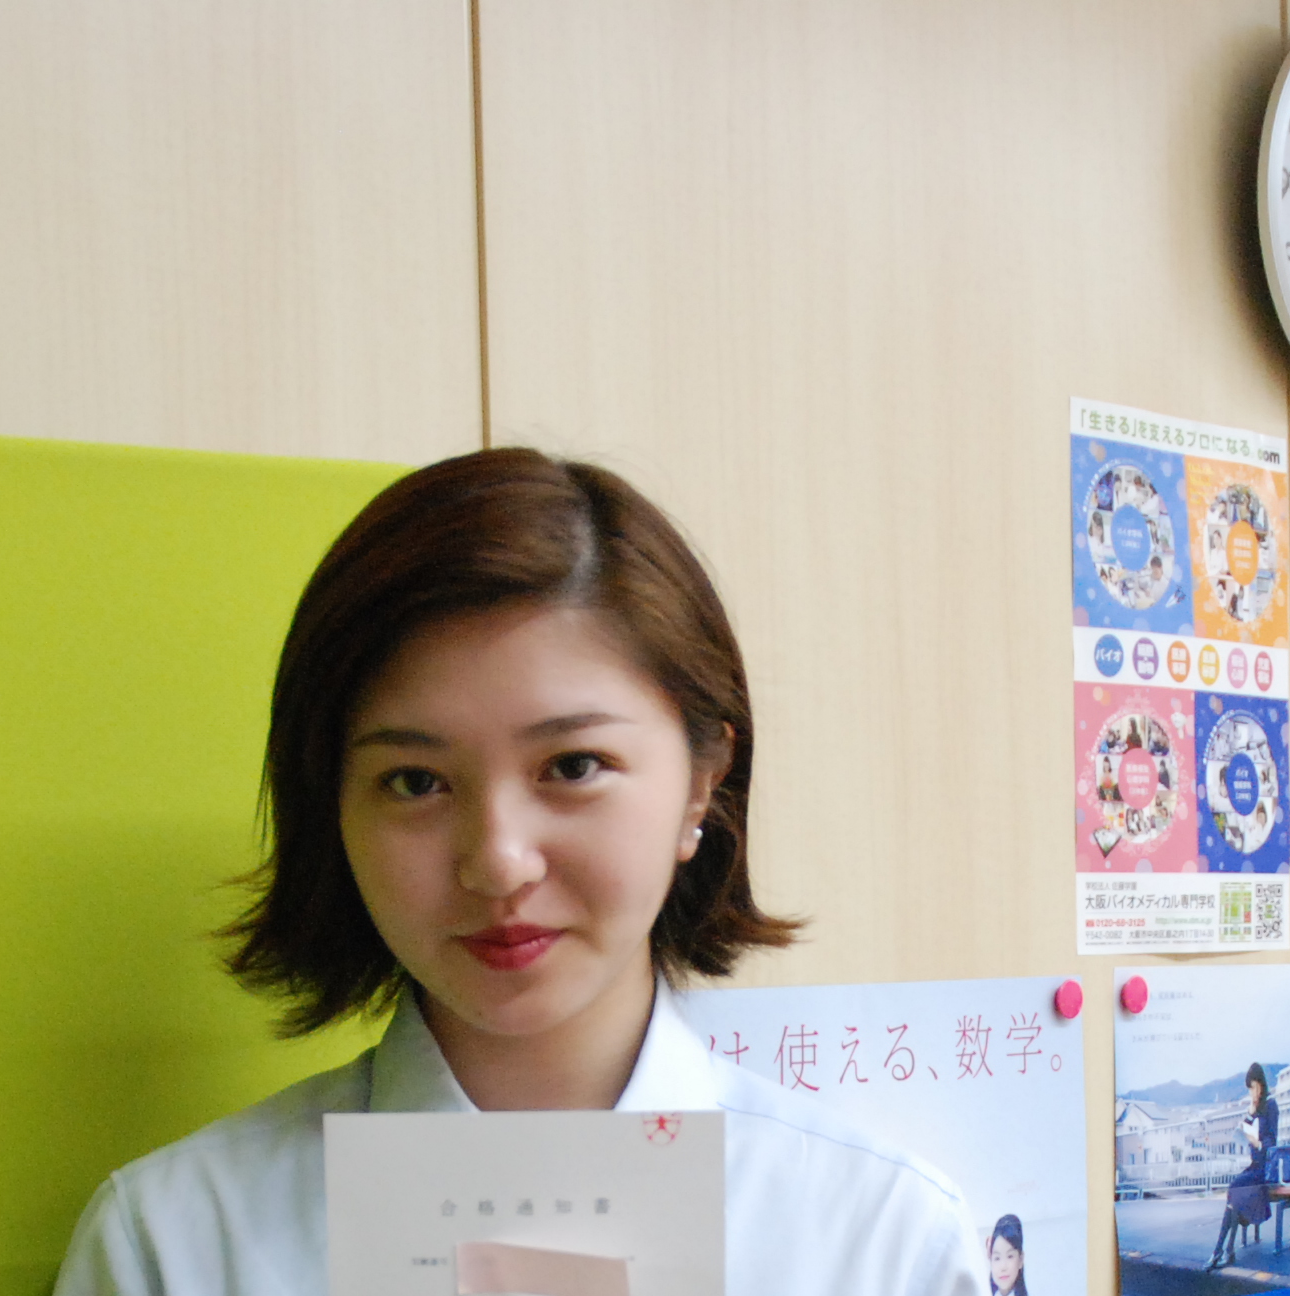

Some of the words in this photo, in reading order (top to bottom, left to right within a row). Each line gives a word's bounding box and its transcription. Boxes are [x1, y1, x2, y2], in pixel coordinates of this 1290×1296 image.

[1085, 893, 1216, 910] 大阪バイオメディカル専門学校
